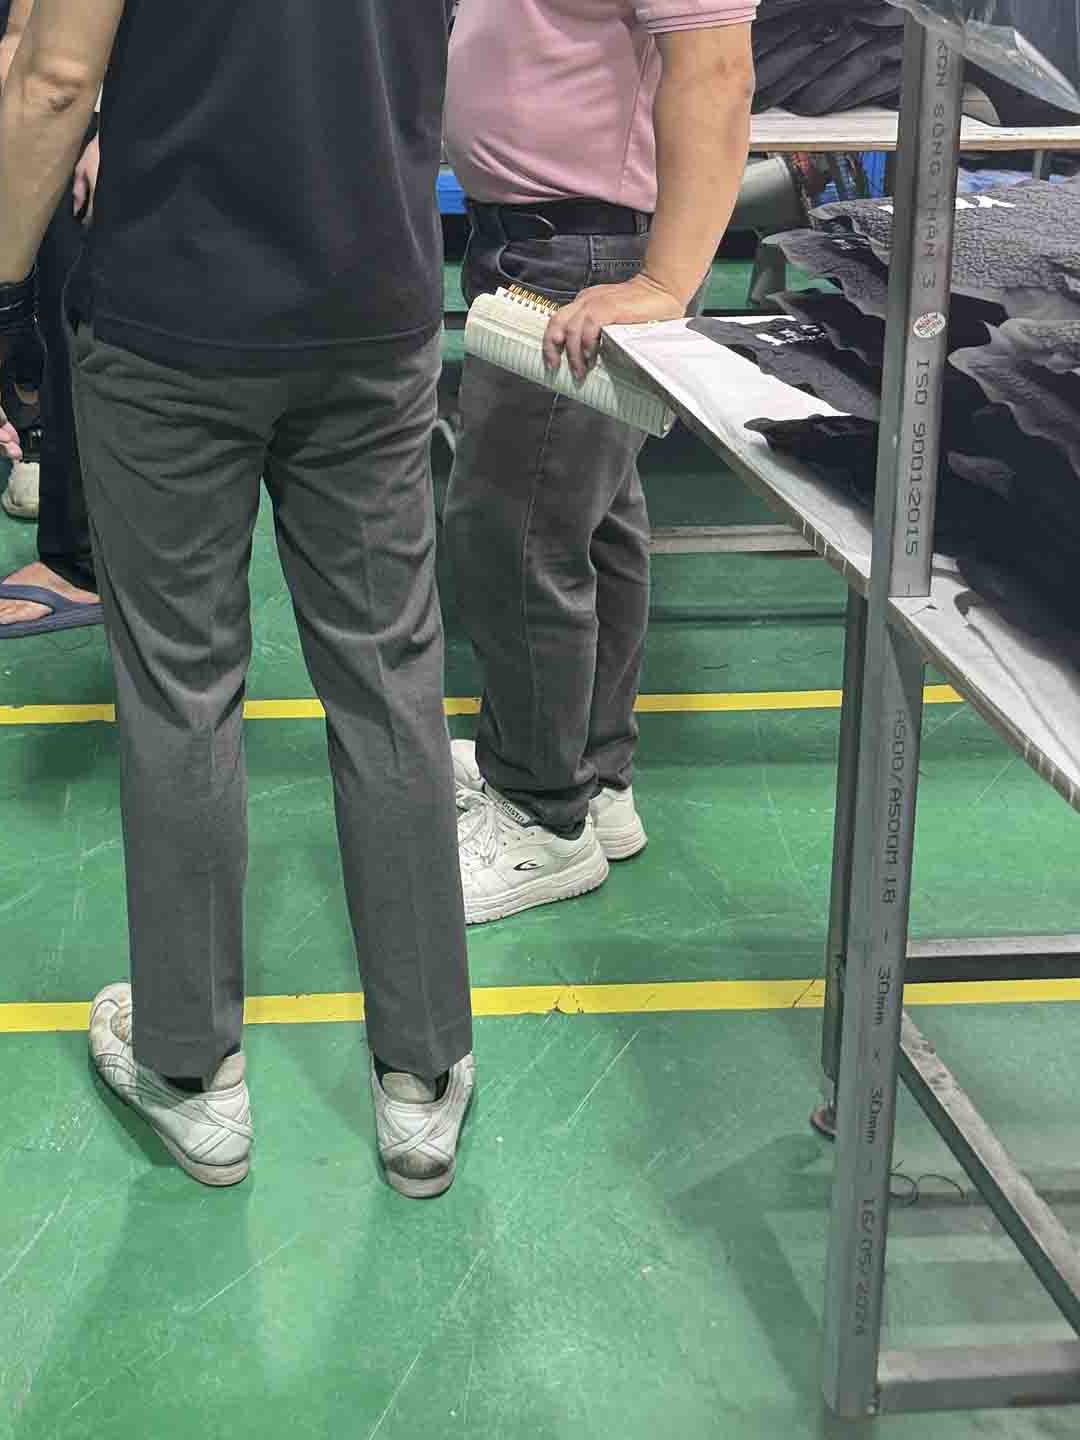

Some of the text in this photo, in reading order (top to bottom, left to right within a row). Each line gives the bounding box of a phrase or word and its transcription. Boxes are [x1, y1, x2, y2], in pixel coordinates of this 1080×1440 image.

[914, 359, 930, 406] ISO
[875, 967, 891, 1026] 30mm
[866, 1087, 883, 1145] 30mm
